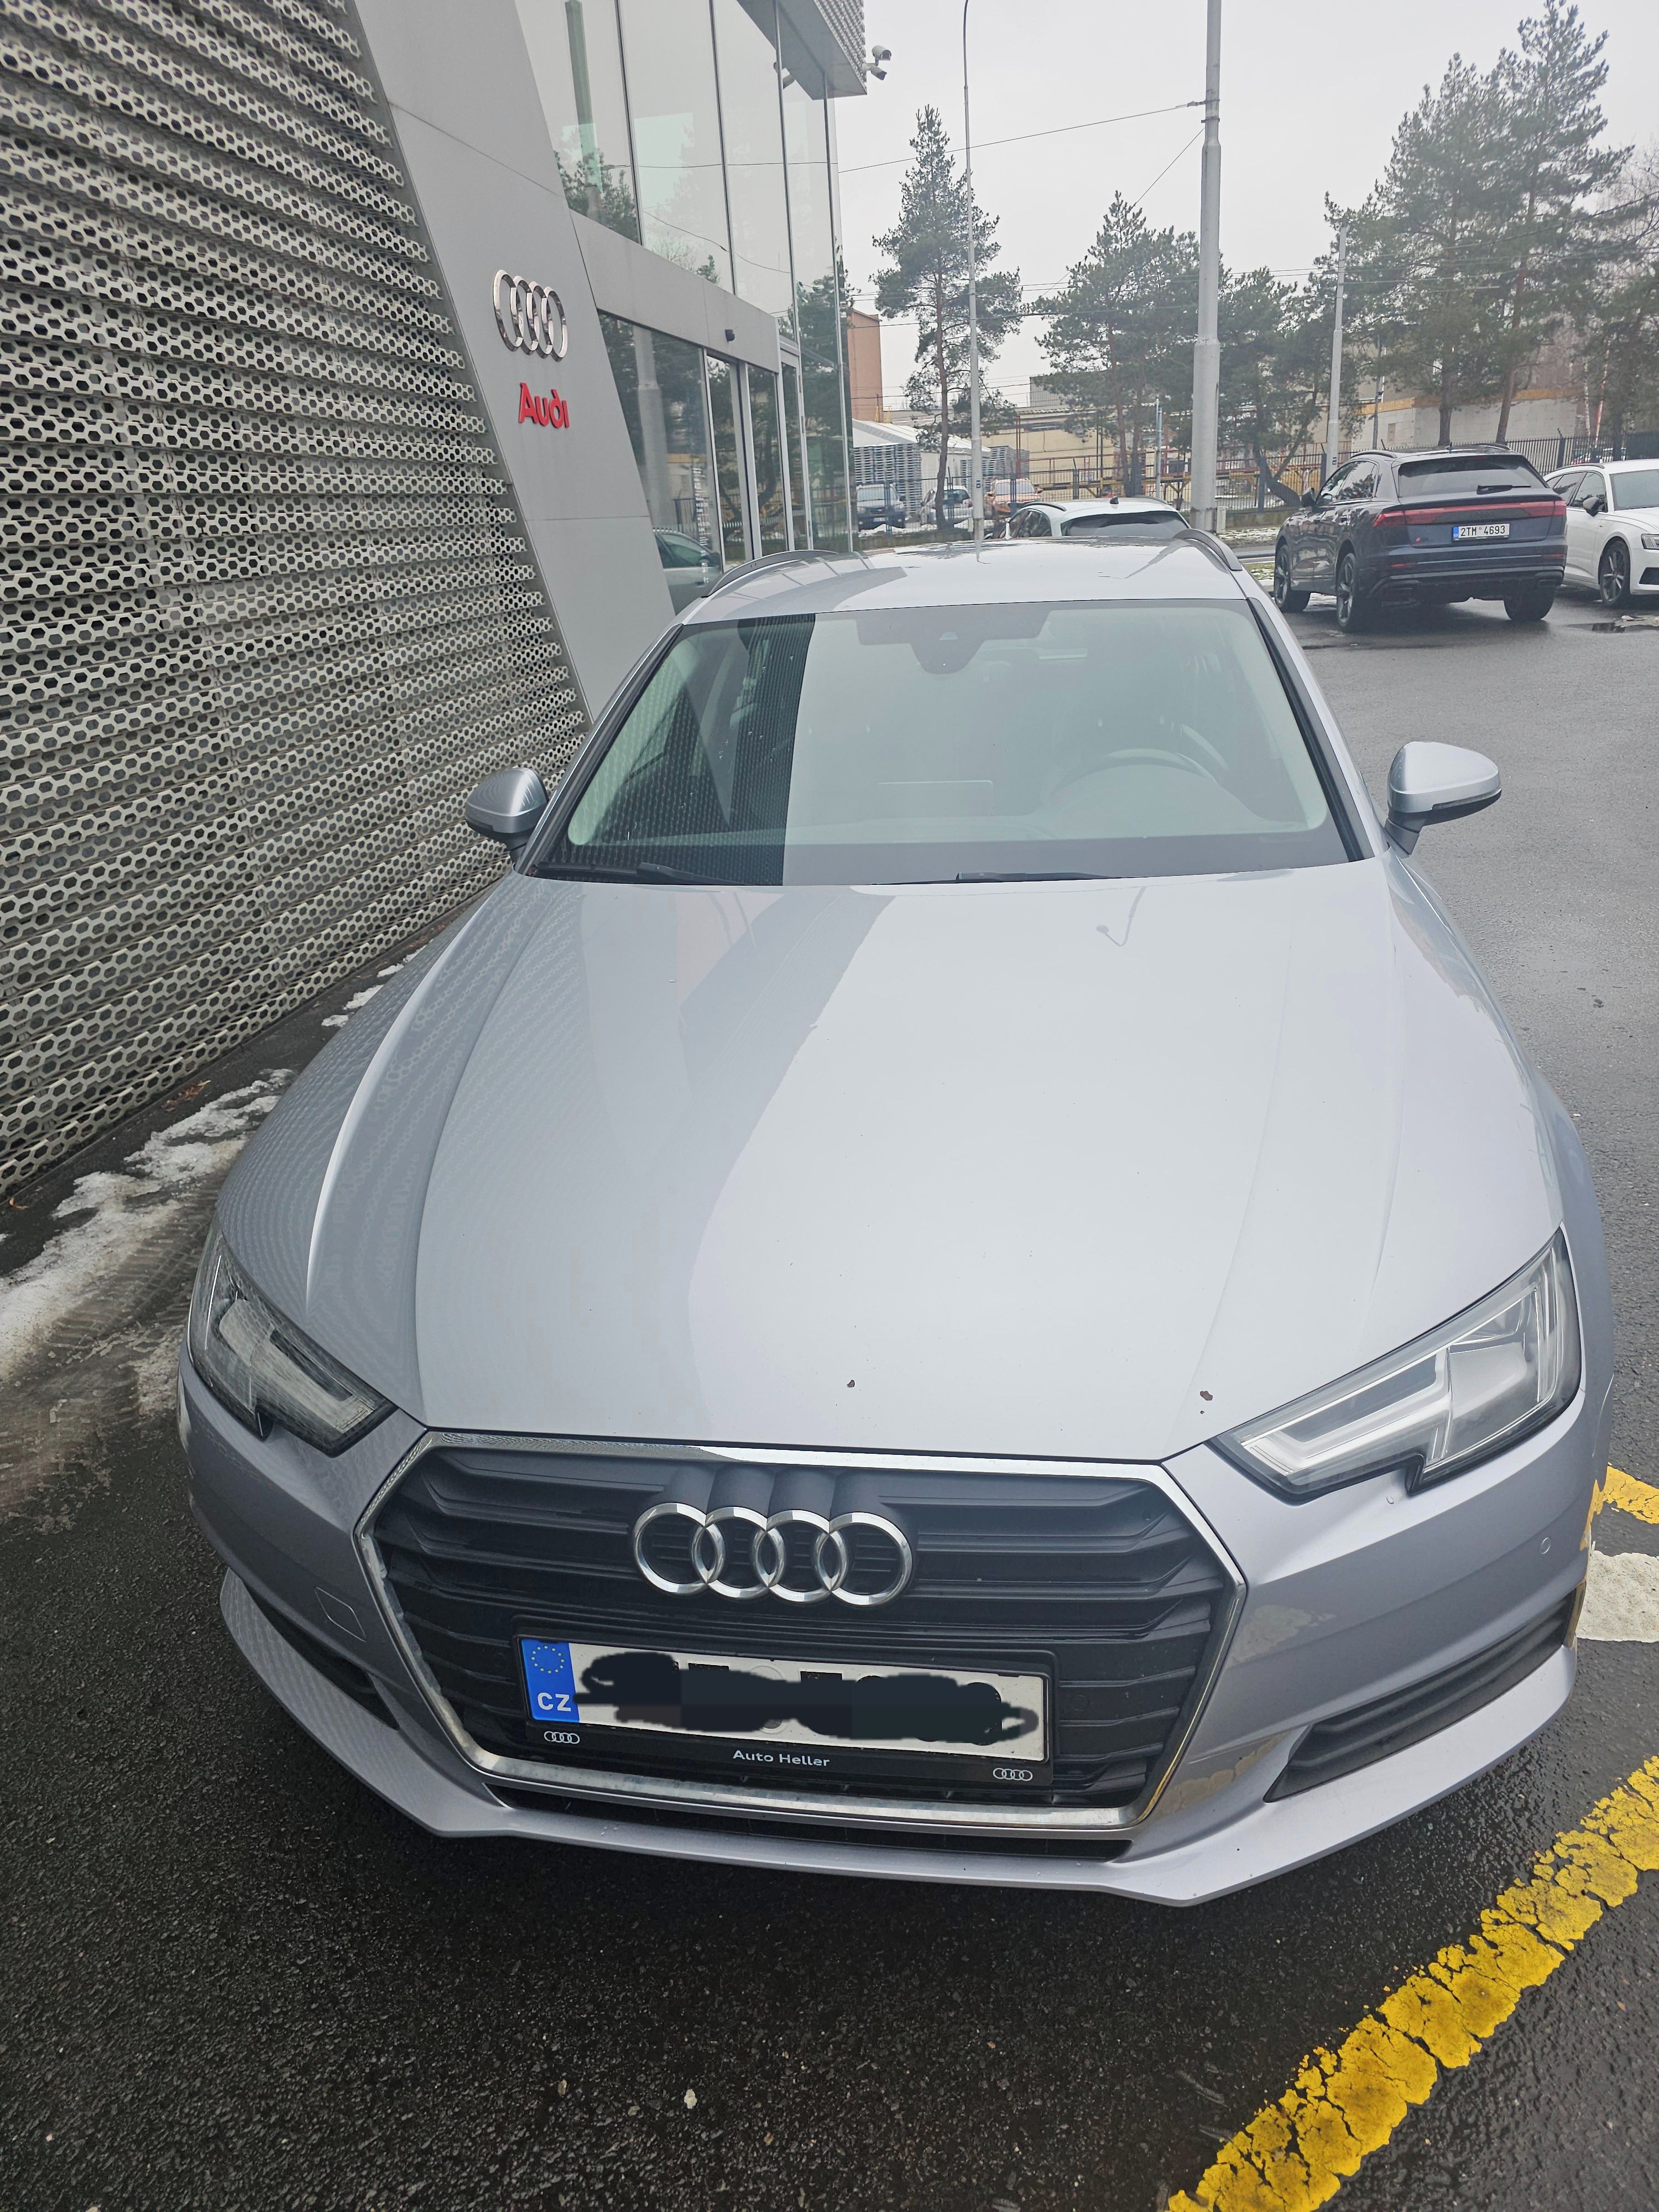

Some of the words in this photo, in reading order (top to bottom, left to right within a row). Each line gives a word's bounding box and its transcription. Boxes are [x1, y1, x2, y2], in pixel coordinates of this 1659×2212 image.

[518, 382, 570, 429] Audi
[1460, 526, 1477, 536] 2TM
[1484, 525, 1505, 535] 4693
[538, 1692, 571, 1712] CZ
[733, 1750, 774, 1762] Auto
[779, 1753, 830, 1766] Heller
